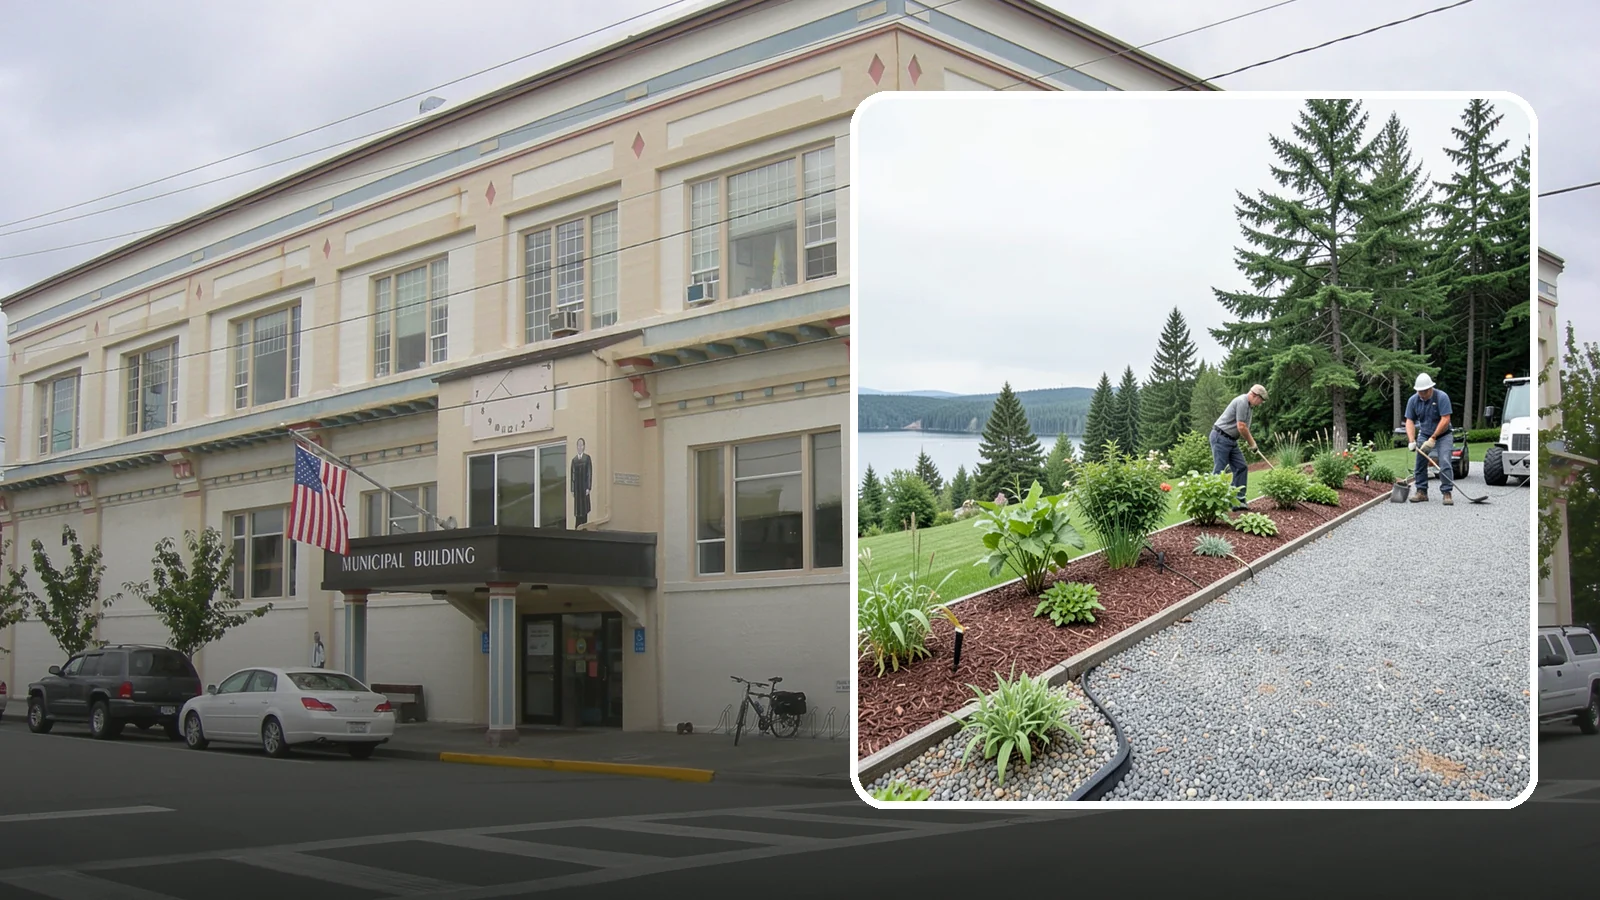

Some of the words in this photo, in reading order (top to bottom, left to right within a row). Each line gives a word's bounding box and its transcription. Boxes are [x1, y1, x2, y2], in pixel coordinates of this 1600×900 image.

[481, 407, 485, 415] 8
[529, 414, 533, 422] 3
[494, 424, 500, 432] 10
[521, 420, 525, 428] 2
[342, 553, 405, 572] MUNICIPAL
[414, 546, 475, 567] BUILDING
